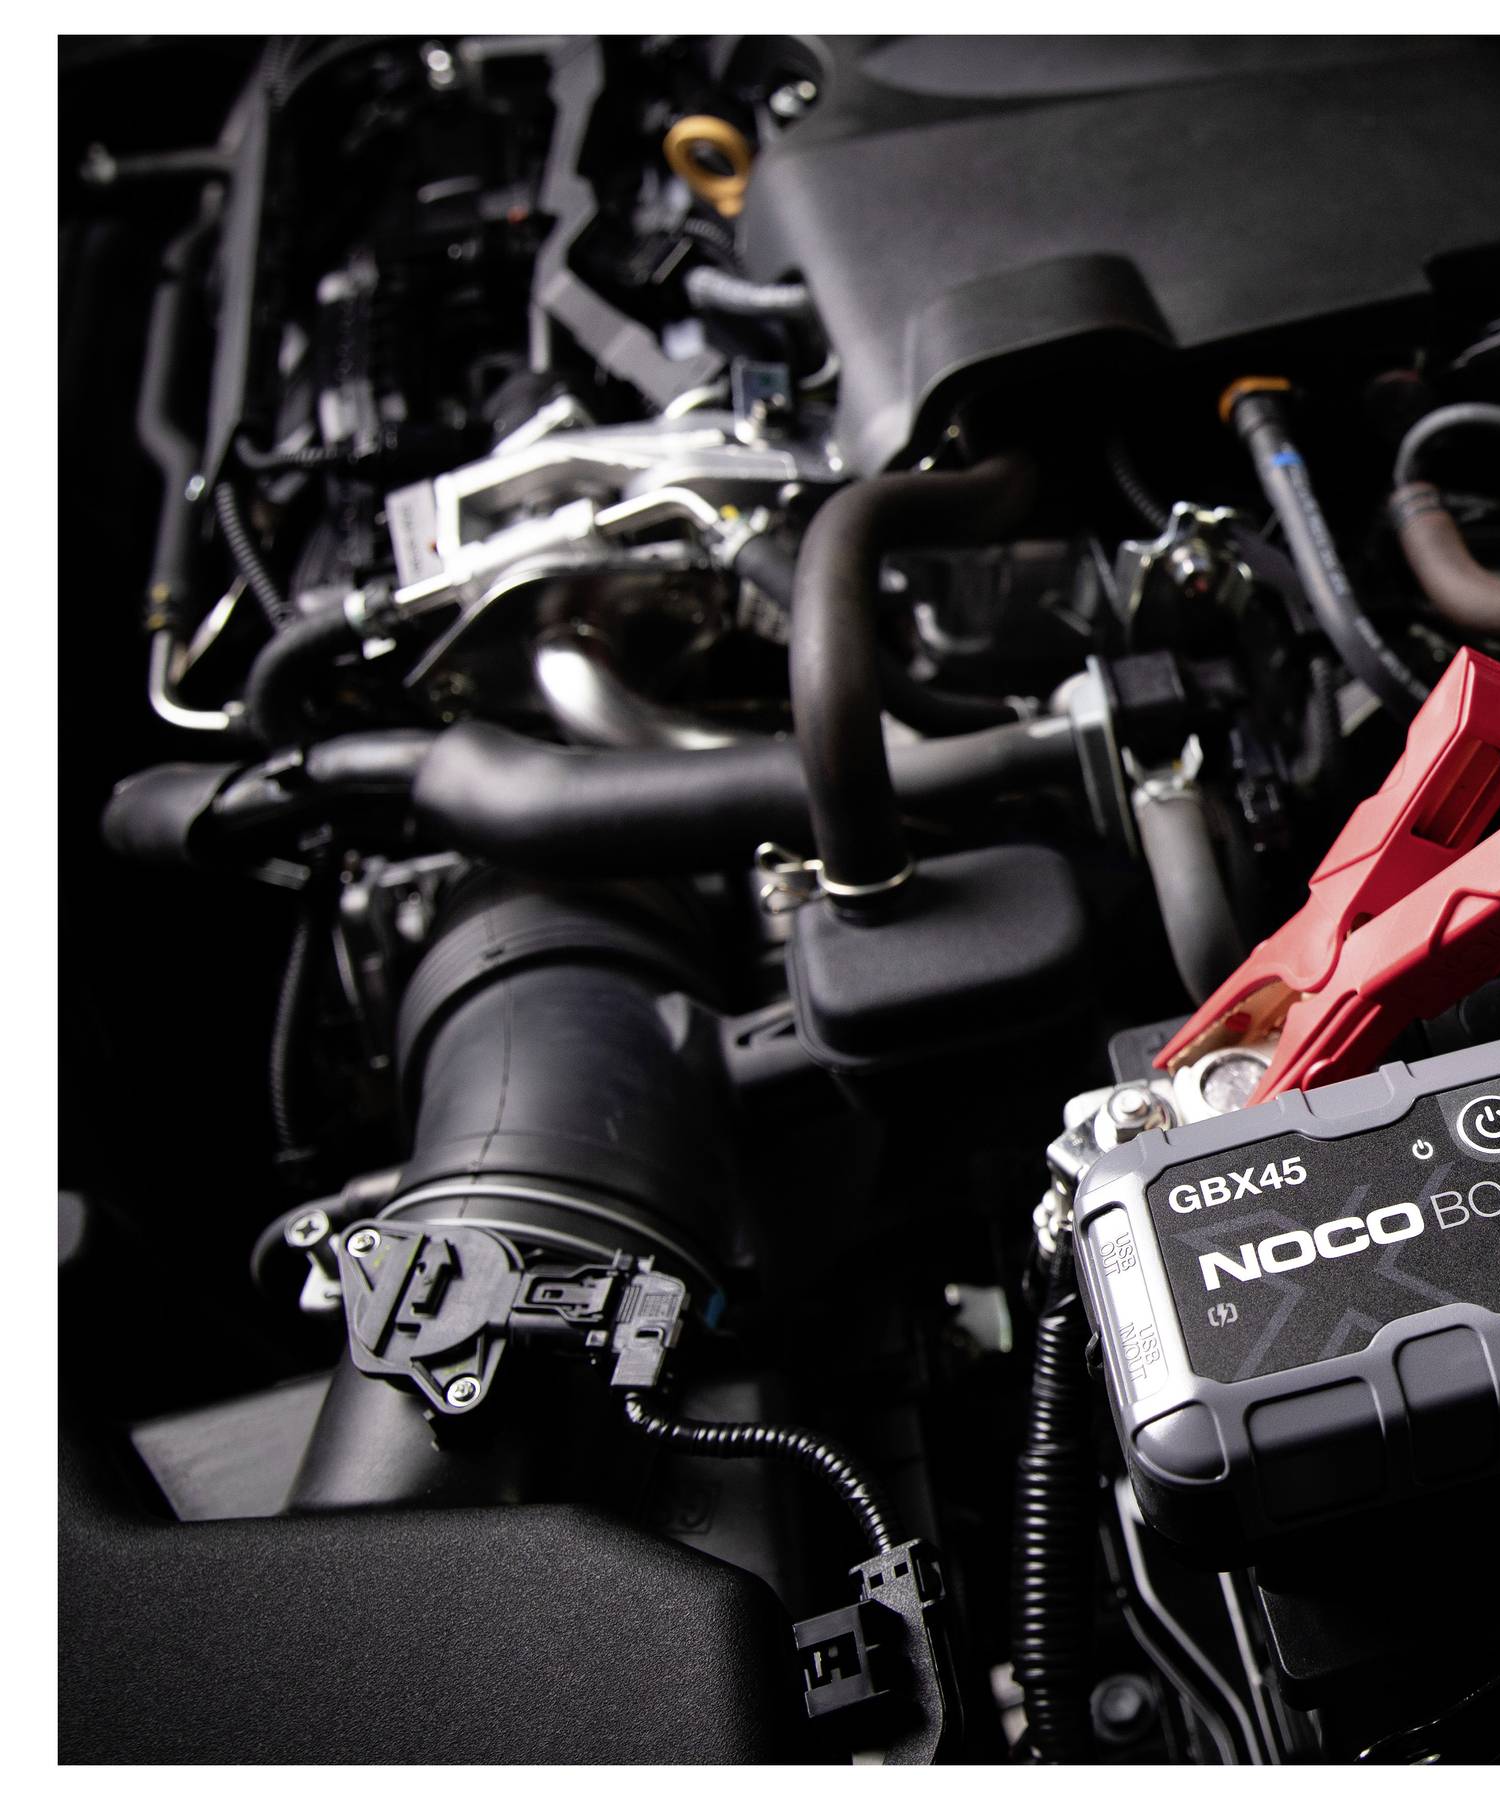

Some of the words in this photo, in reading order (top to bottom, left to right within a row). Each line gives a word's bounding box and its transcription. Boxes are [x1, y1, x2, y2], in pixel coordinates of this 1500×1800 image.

[1168, 1156, 1307, 1214] GBX45
[1100, 1242, 1121, 1277] OUT
[1115, 1232, 1137, 1272] USB
[1198, 1202, 1425, 1291] NOCO
[1120, 1322, 1147, 1382] IN/OUT
[1139, 1323, 1161, 1366] USB
